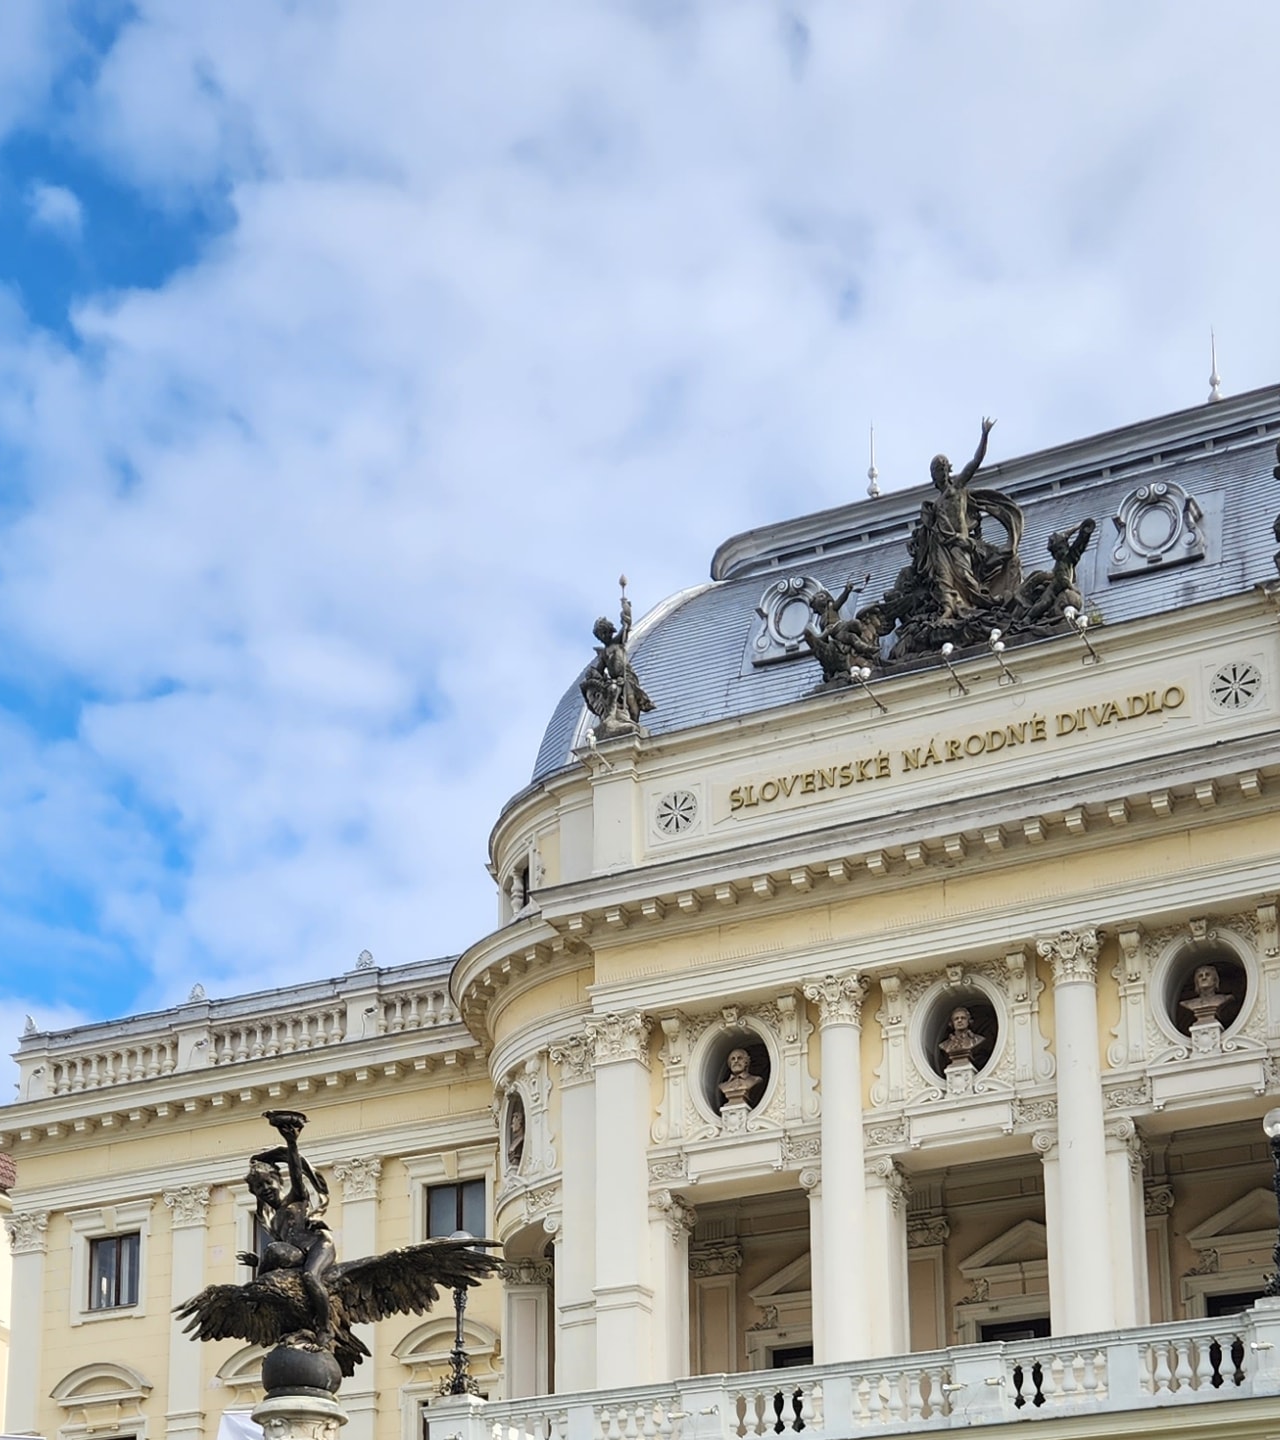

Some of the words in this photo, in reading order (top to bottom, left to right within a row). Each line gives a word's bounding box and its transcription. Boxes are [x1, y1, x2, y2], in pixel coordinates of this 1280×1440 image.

[729, 750, 891, 812] SLOVENSKÉ
[901, 713, 1047, 772] NÁRODNÉ
[1056, 686, 1185, 736] DIVADLO
